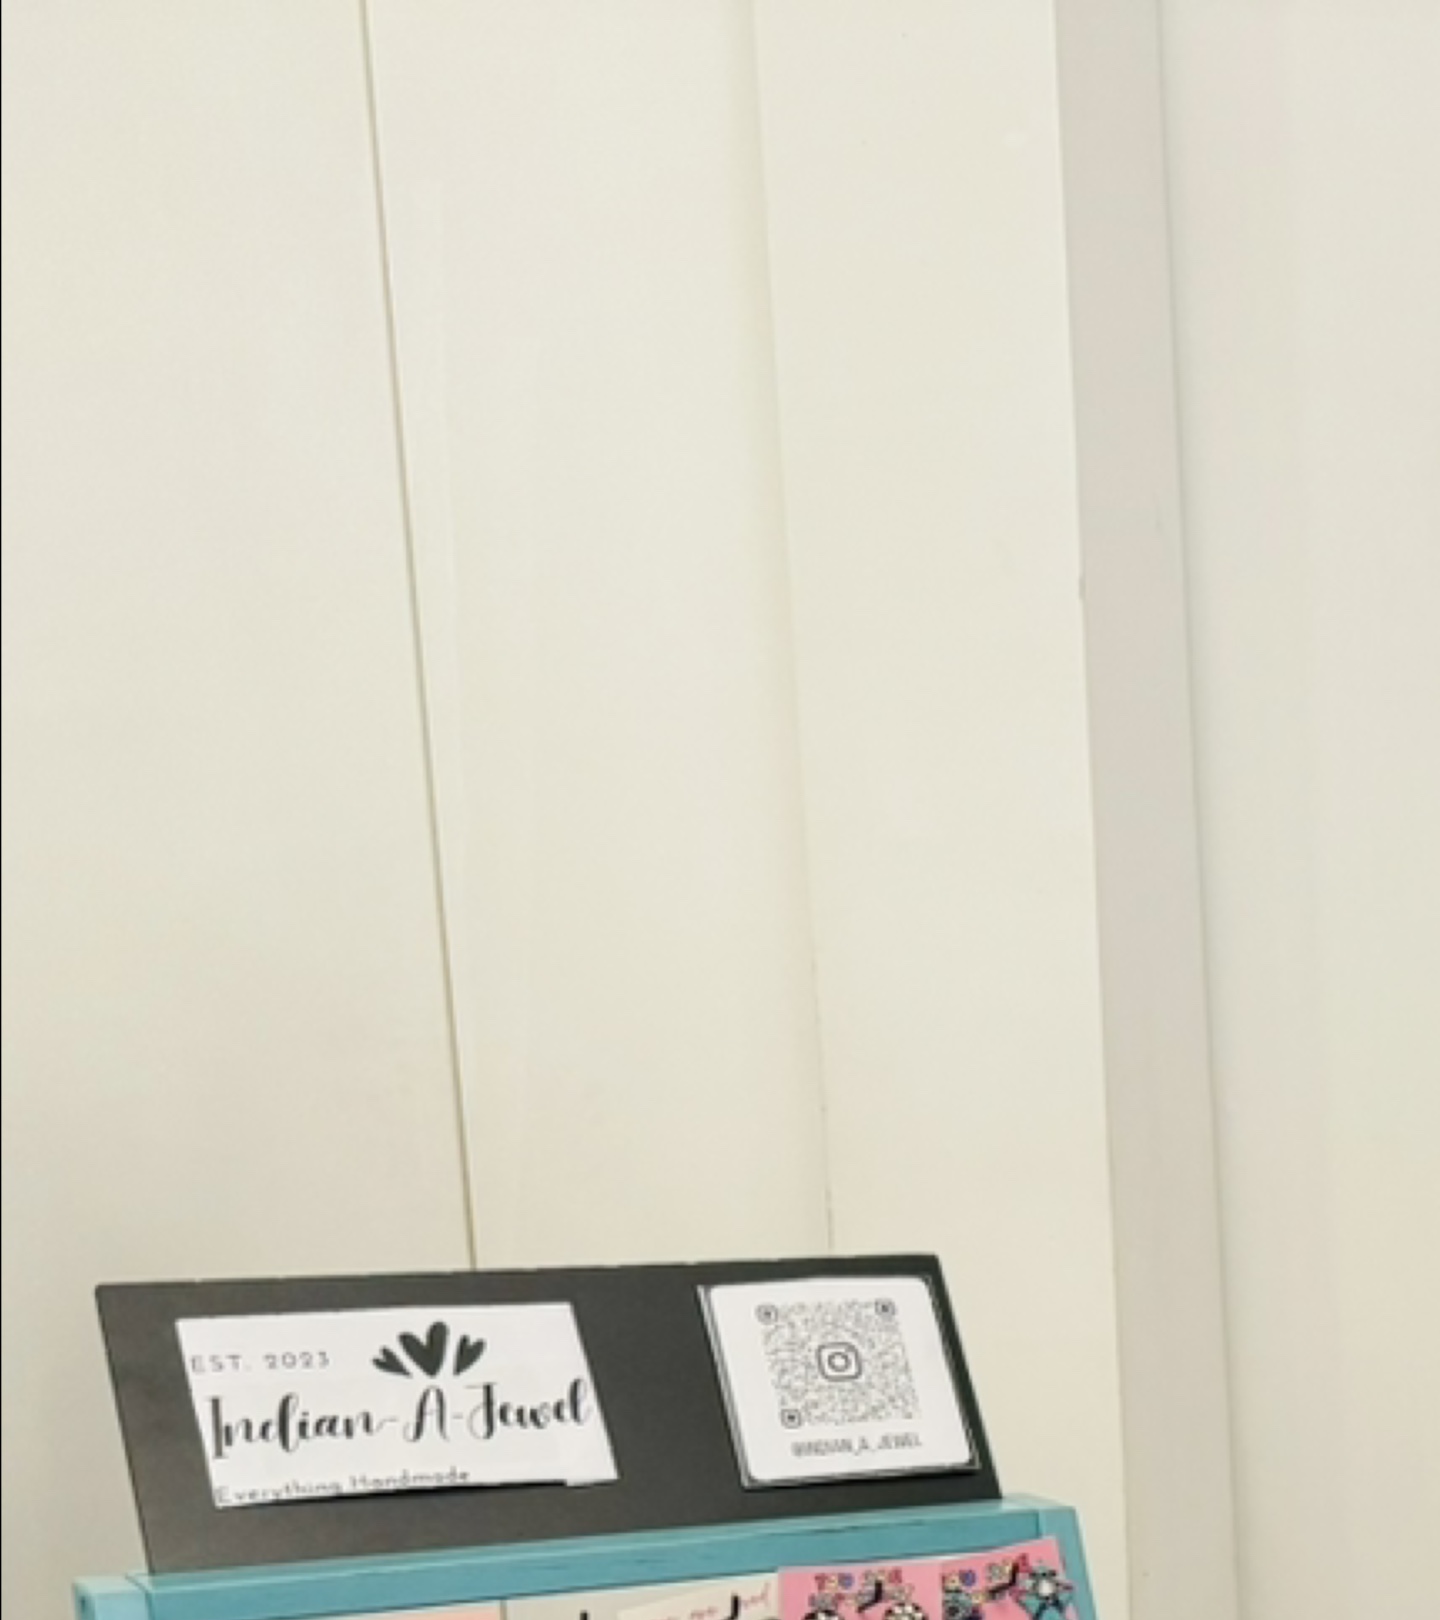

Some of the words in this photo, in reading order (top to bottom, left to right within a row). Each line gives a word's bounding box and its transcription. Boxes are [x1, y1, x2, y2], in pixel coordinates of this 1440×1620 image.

[190, 1354, 251, 1374] EST.
[264, 1351, 331, 1371] 2023
[208, 1377, 593, 1460] Indian-A-Jewel
[348, 1465, 471, 1489] Handmade
